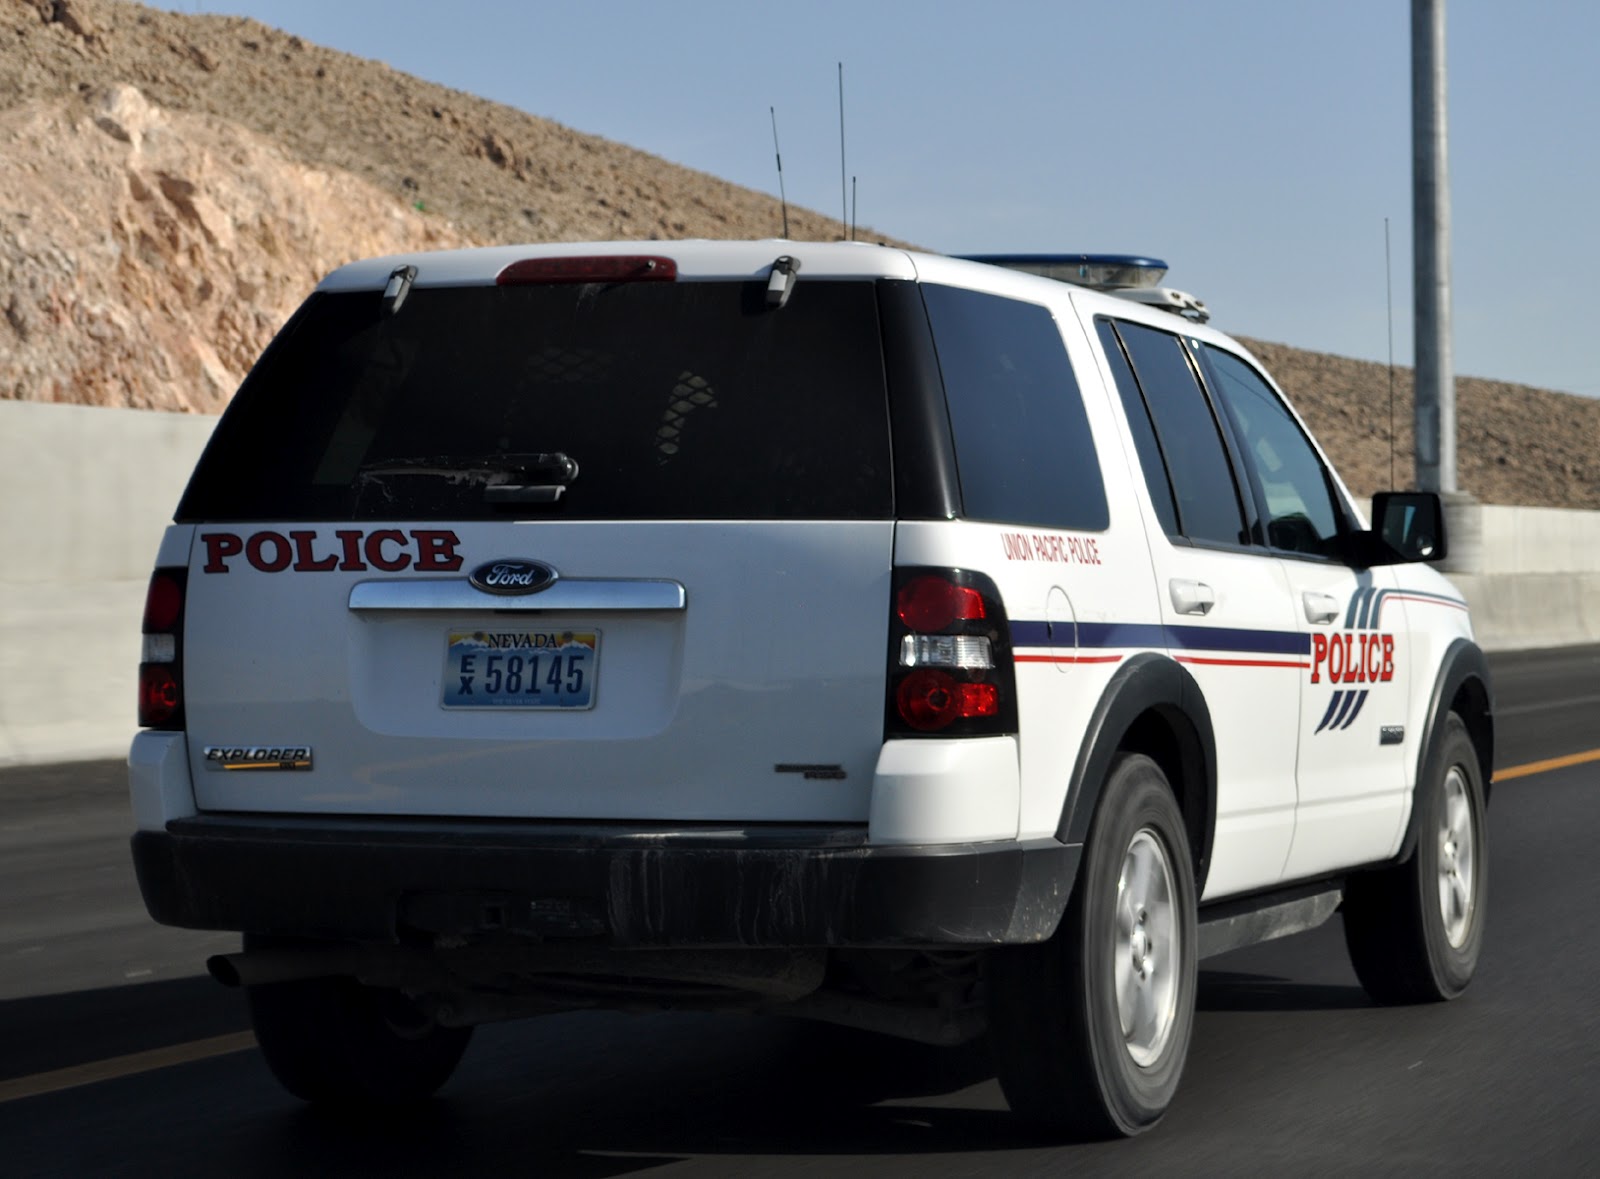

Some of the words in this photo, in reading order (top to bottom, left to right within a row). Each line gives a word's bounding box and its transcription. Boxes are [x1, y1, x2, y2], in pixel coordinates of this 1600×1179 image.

[200, 529, 465, 574] POLICE
[1000, 532, 1034, 561] UNION
[1032, 534, 1069, 563] PACIFIC
[1067, 536, 1102, 565] POLICE
[485, 563, 536, 585] Ford
[488, 633, 559, 649] NEVADA
[484, 654, 585, 695] 58145
[1310, 632, 1395, 685] POLICE
[206, 747, 307, 761] EXPLORER
